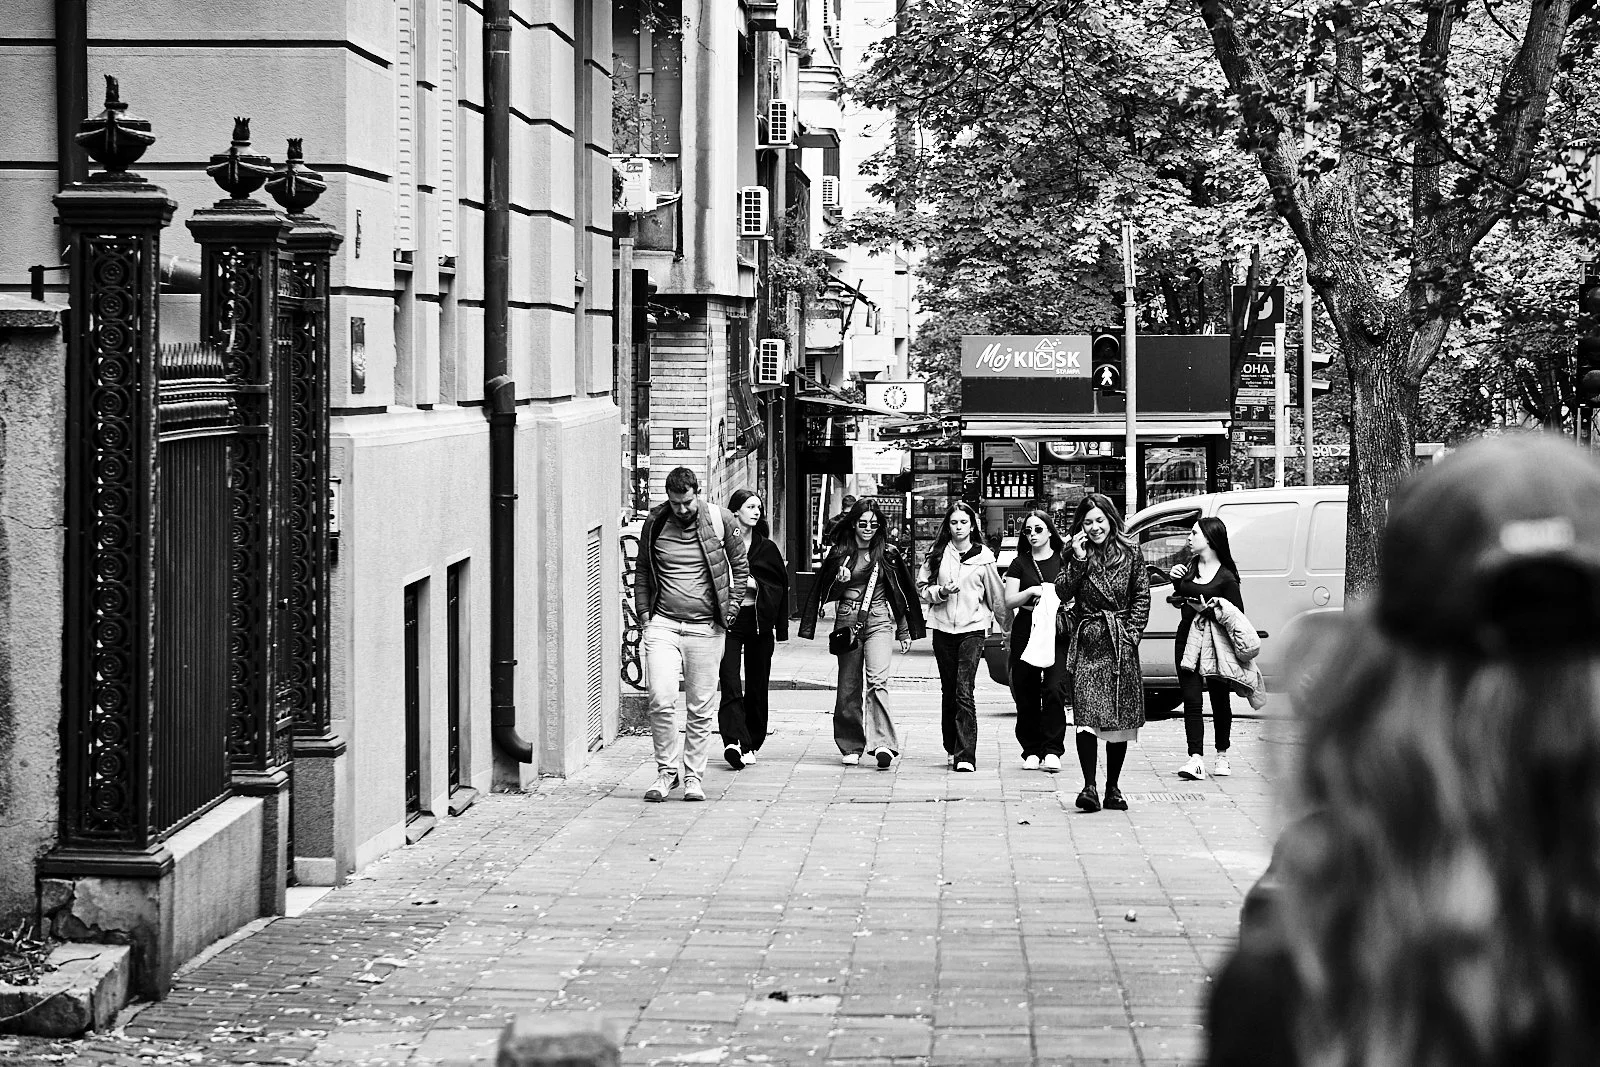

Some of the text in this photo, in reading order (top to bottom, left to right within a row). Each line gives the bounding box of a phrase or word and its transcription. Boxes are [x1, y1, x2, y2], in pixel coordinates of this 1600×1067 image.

[975, 342, 1080, 372] Moj KIOSK
[1240, 363, 1270, 374] ОНА
